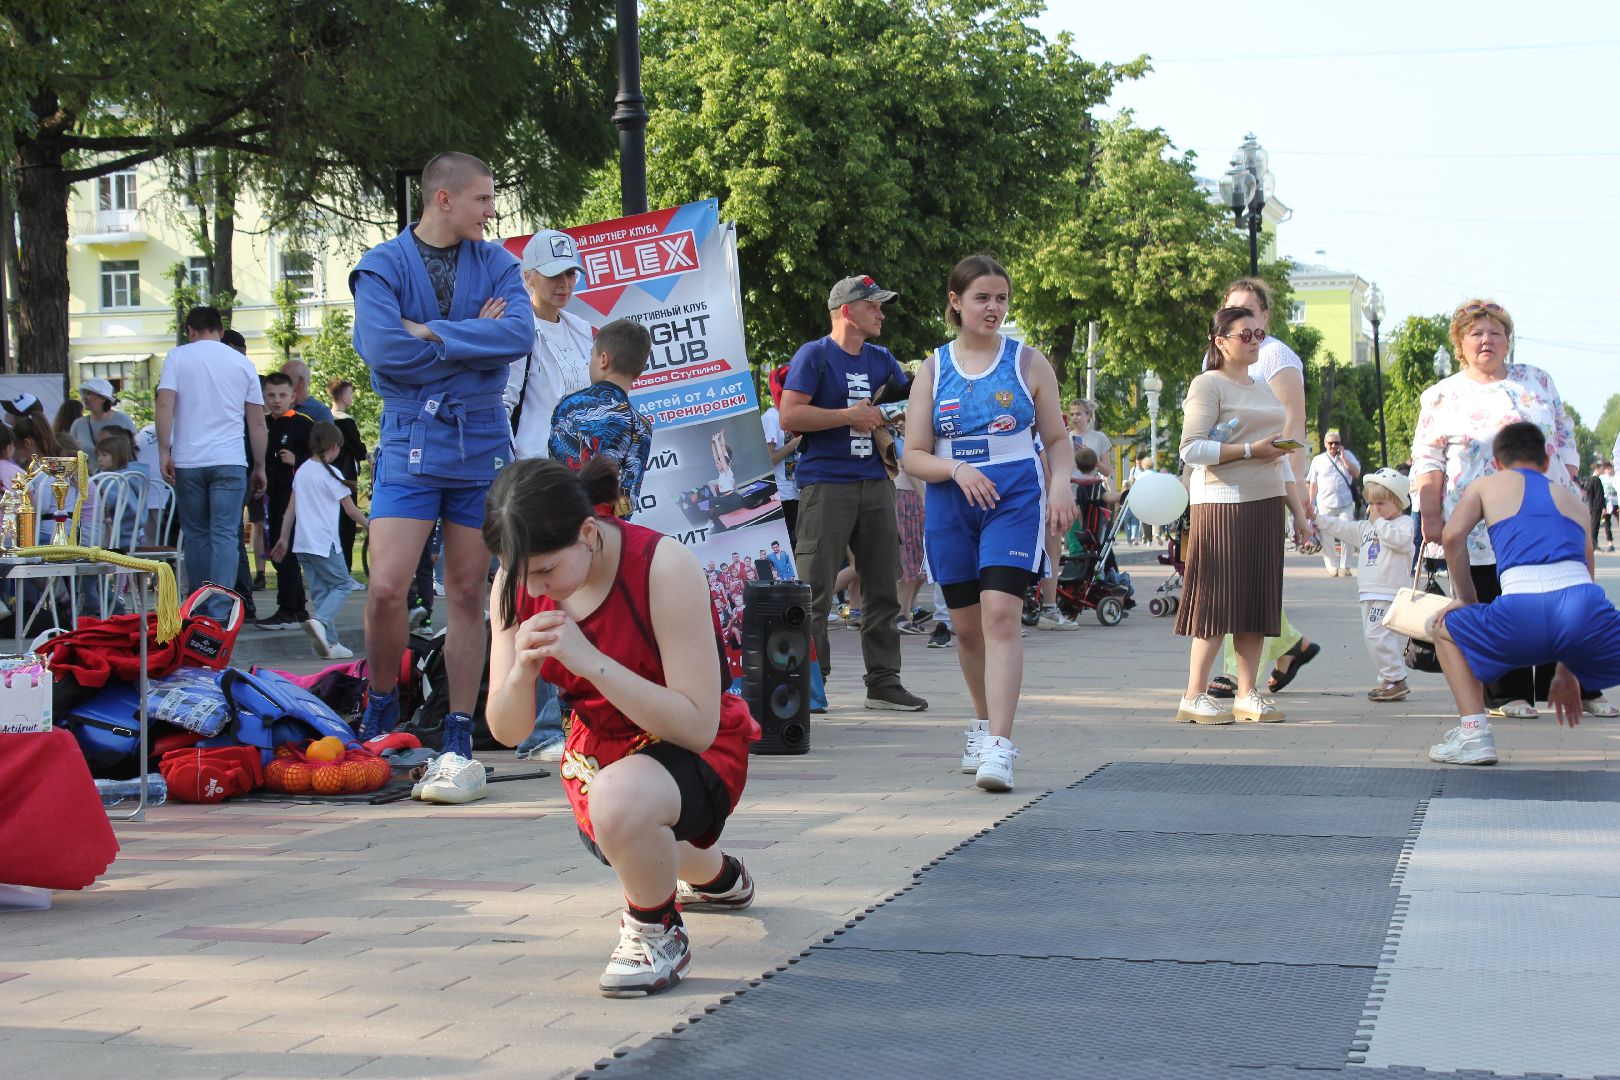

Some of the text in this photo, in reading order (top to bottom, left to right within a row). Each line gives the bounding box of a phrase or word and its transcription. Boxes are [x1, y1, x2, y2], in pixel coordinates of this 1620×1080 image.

[589, 229, 627, 245] ПАРТНЕР
[630, 224, 658, 237] КЛУБА
[585, 235, 695, 285] FLEX
[625, 301, 707, 323] ОРТИВНЫЙ КЛУБ
[650, 314, 710, 345] GHT
[643, 340, 709, 371] LUB
[632, 363, 721, 388] Новое Ступино
[638, 382, 743, 414] детей от 4 лет
[645, 393, 746, 424] а тренировки
